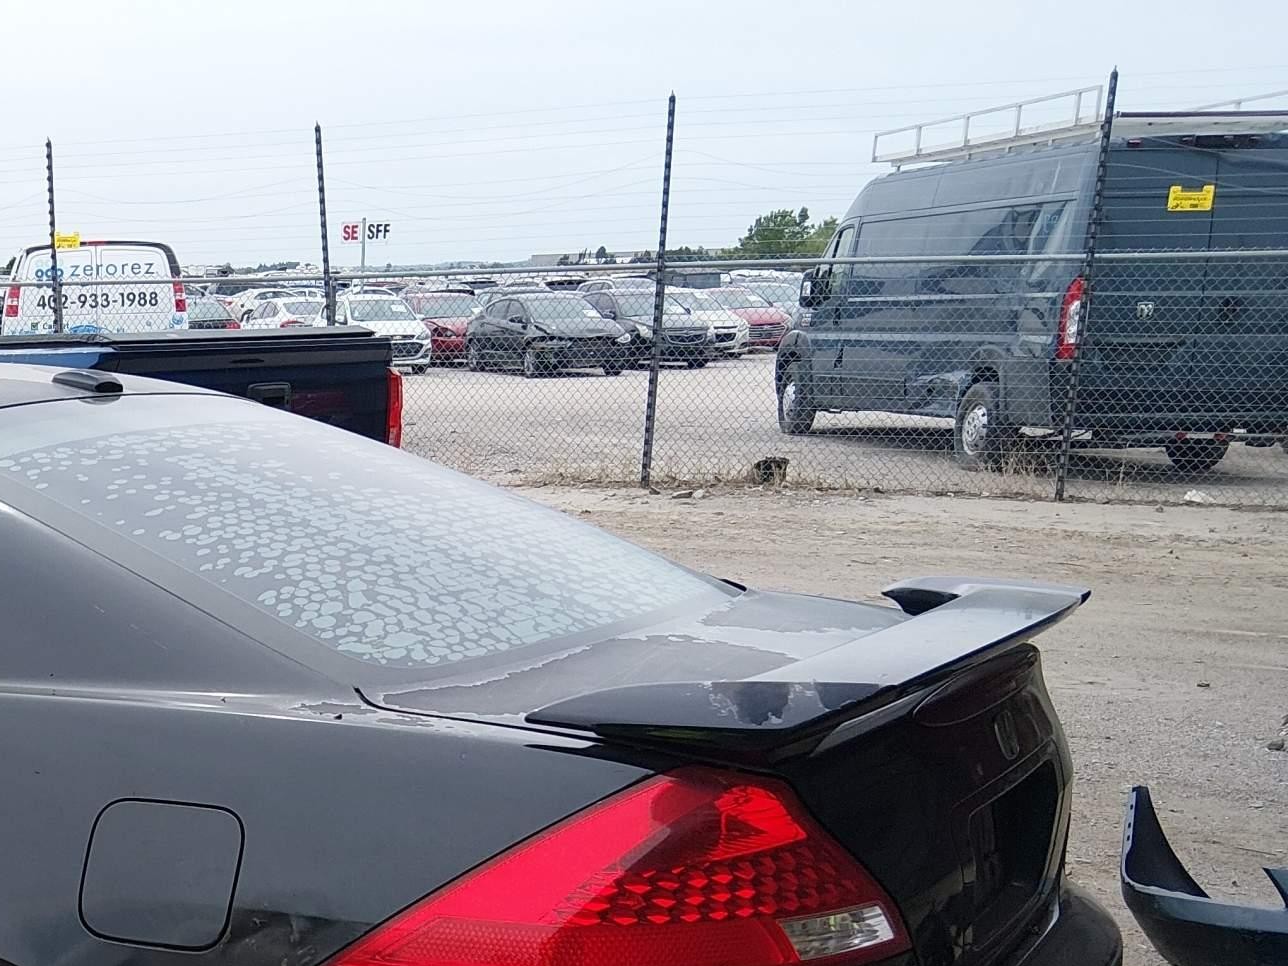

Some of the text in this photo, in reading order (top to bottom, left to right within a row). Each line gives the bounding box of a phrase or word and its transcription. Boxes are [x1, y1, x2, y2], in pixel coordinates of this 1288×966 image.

[343, 224, 359, 241] SE
[367, 223, 391, 240] SFF
[70, 262, 155, 277] zerorez
[36, 291, 159, 310] 402-933-1988
